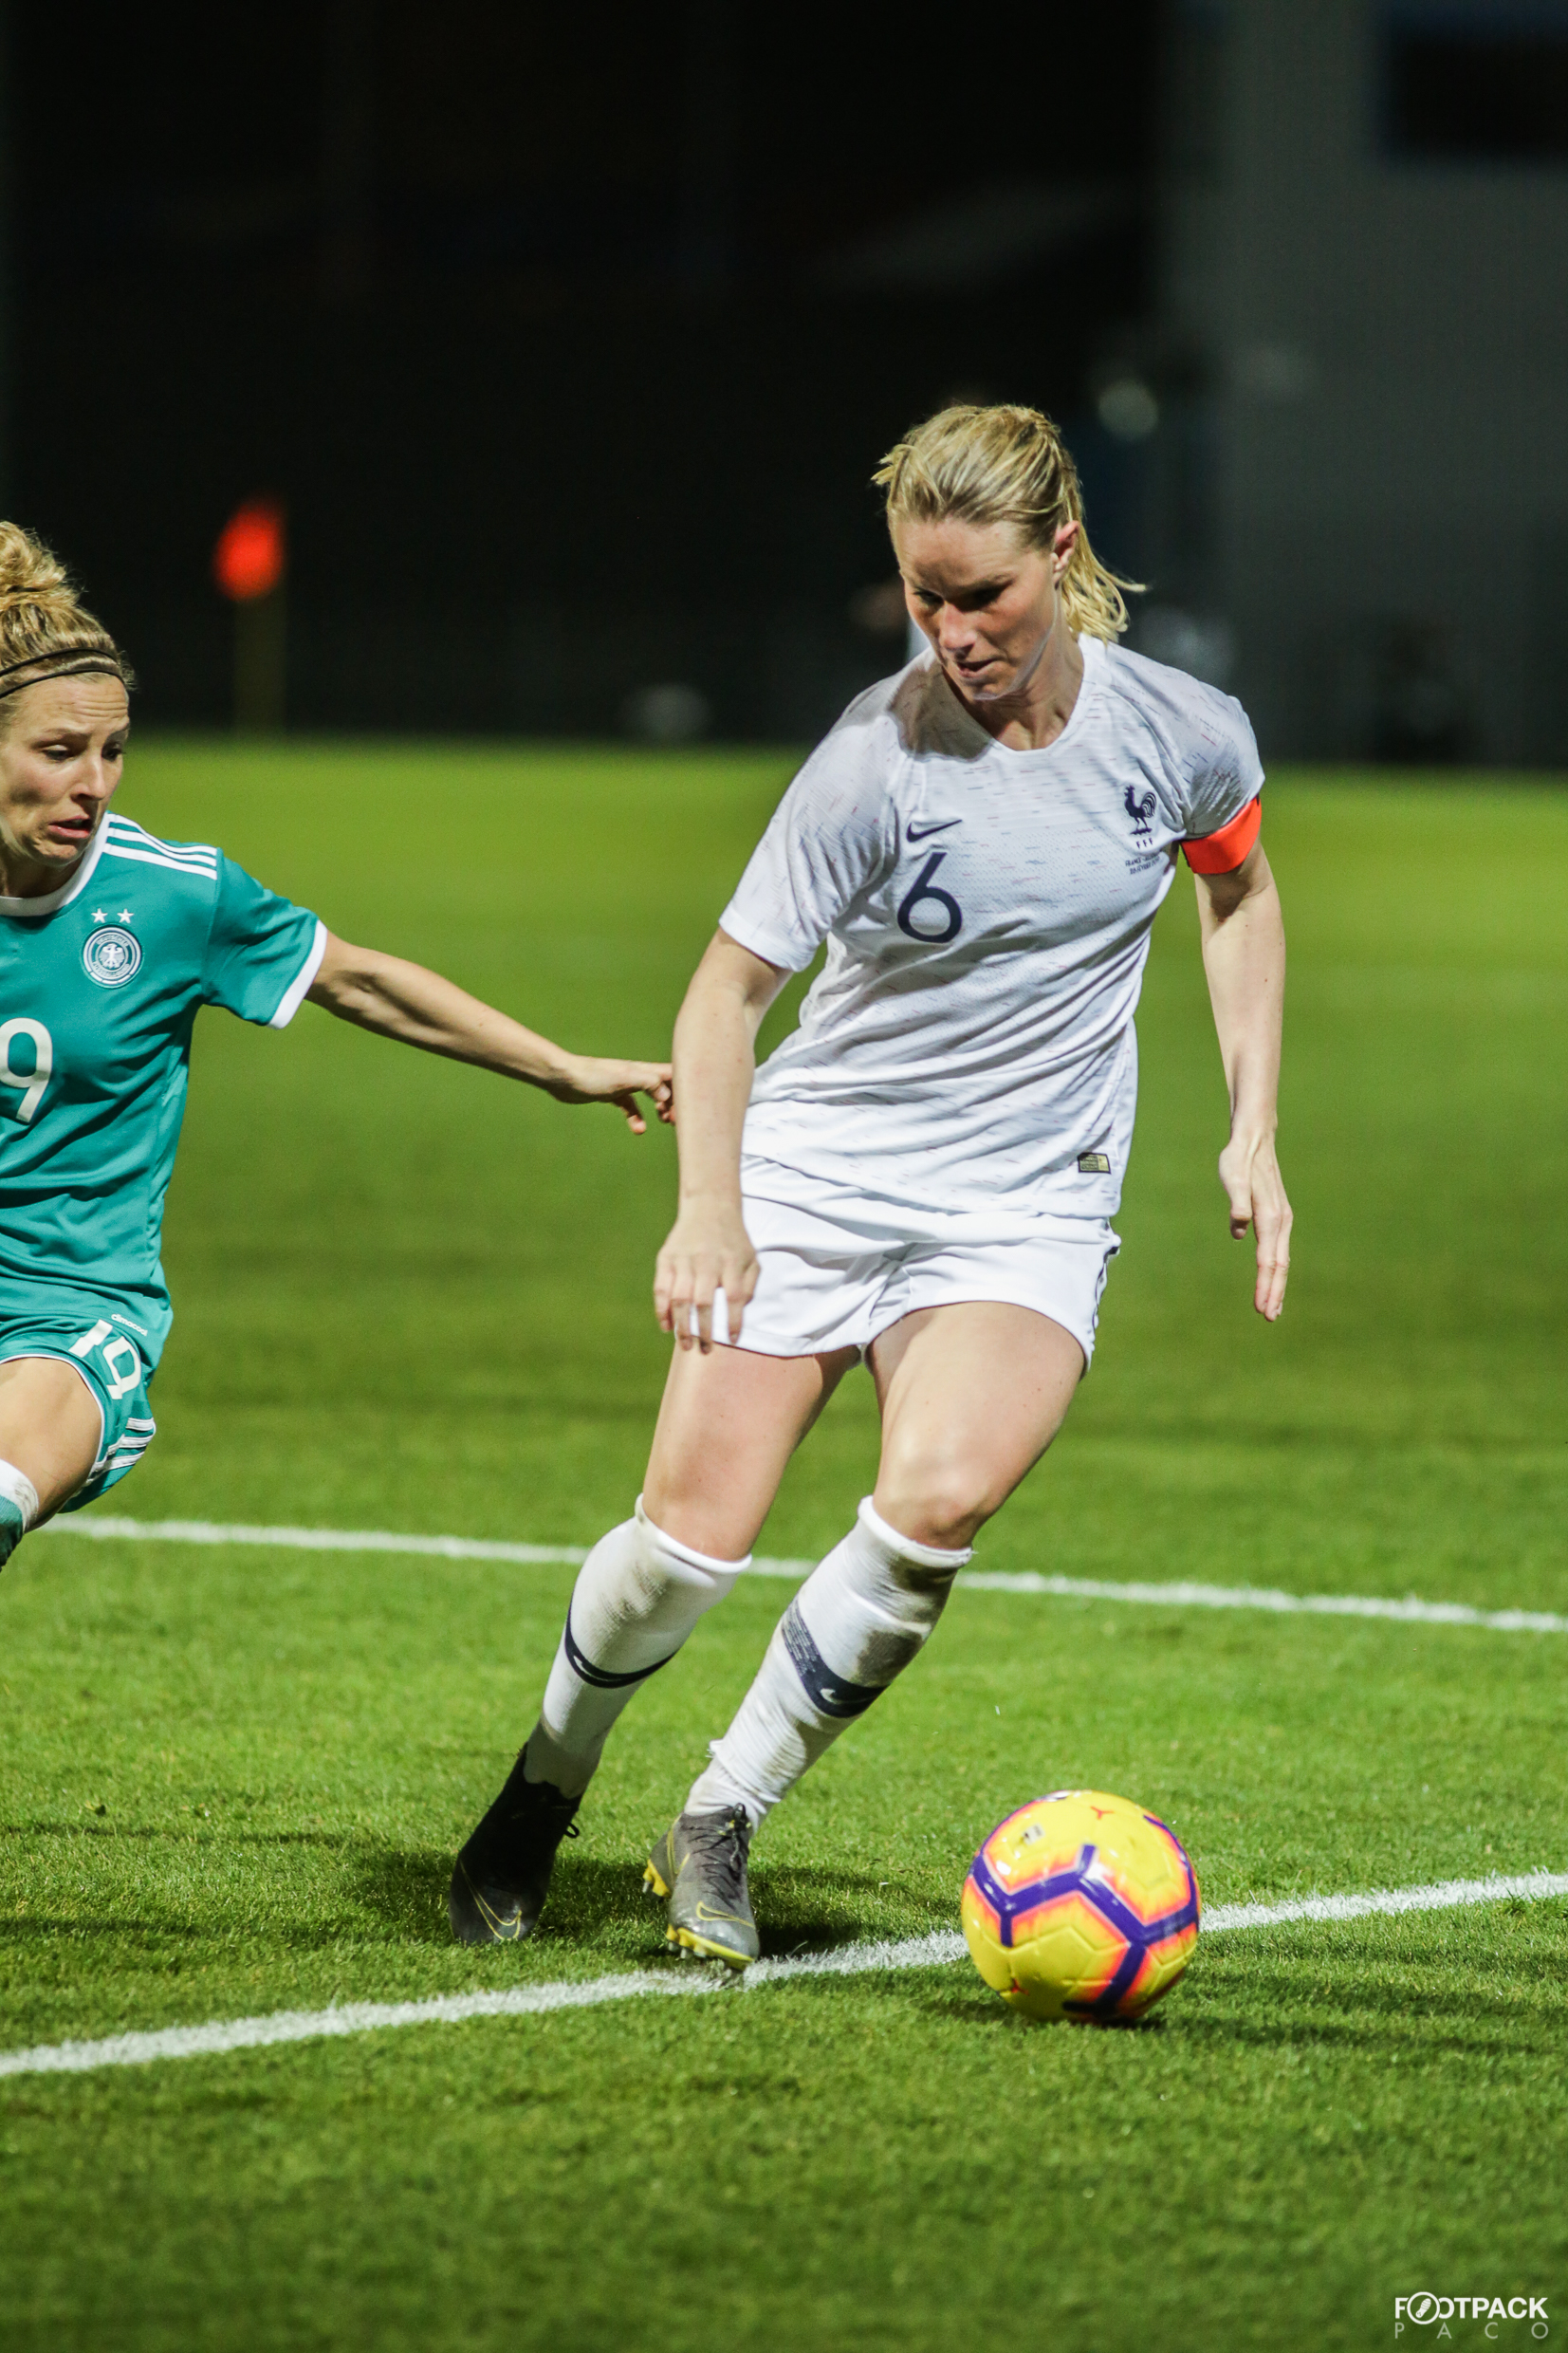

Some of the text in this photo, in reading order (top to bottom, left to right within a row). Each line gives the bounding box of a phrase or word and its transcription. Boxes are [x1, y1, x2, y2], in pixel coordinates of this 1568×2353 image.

[897, 852, 963, 944] 6
[0, 1017, 52, 1122] 9
[68, 1319, 141, 1399] 19
